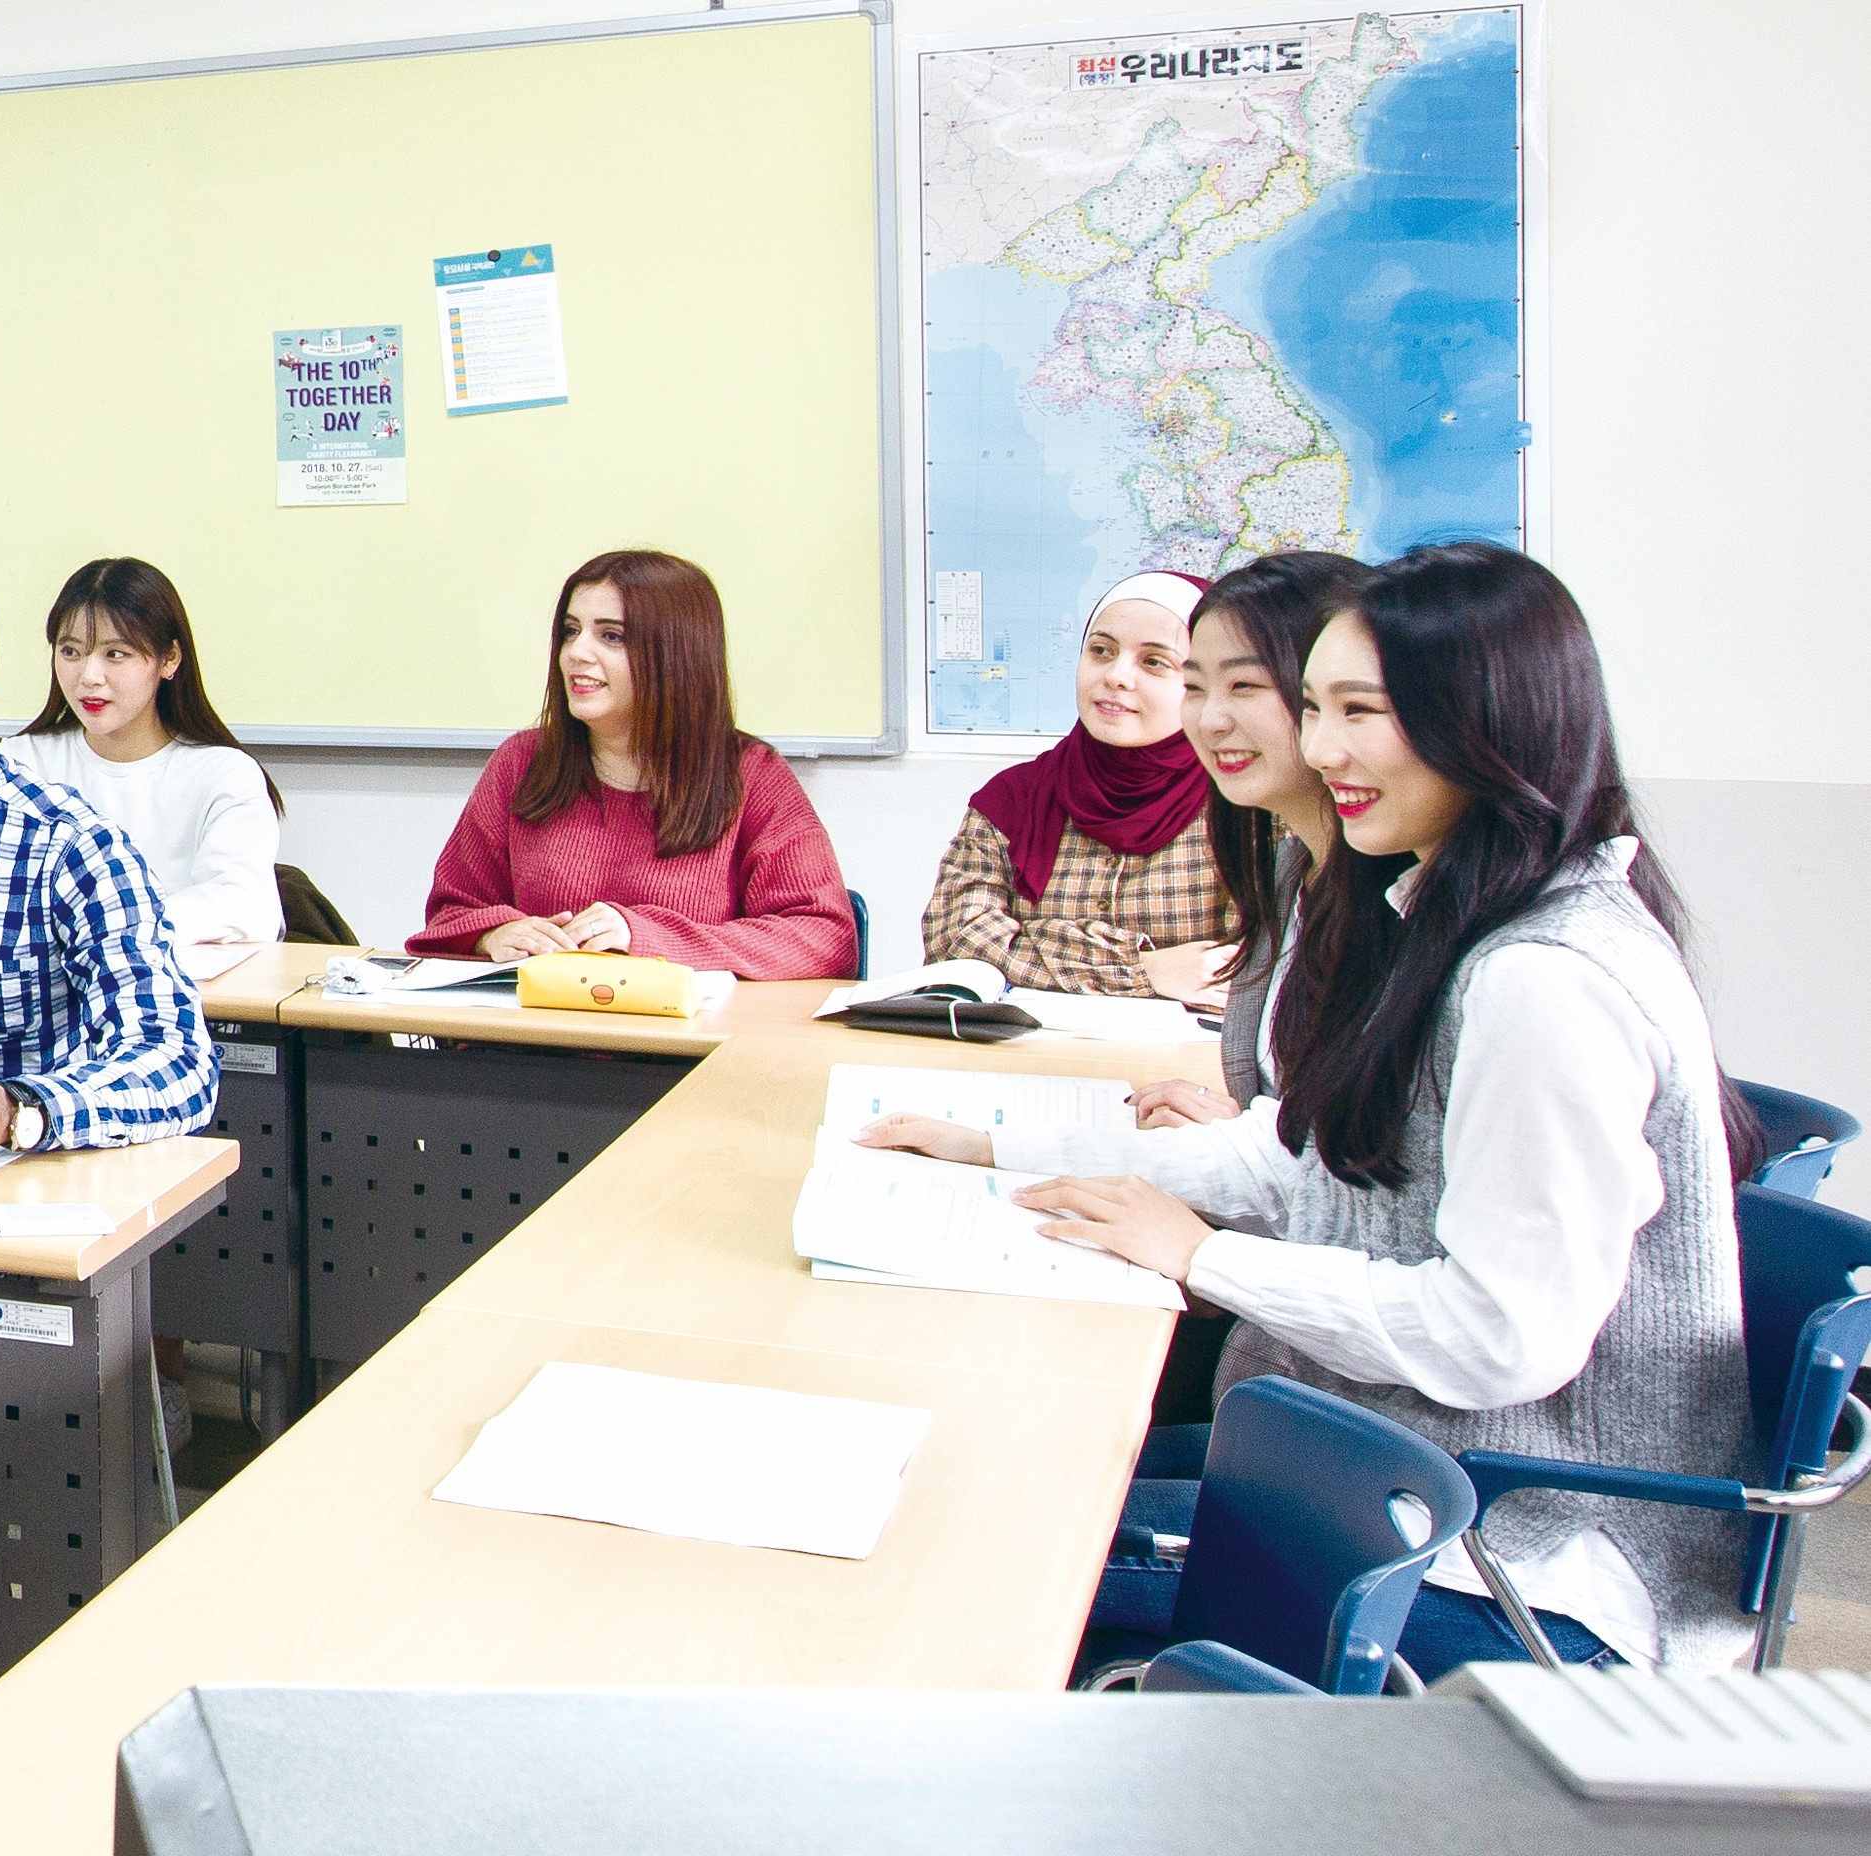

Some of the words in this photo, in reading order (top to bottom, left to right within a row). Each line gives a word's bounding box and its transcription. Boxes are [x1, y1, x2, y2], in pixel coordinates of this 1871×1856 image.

[1077, 57, 1116, 73] 최신
[1120, 41, 1303, 83] 우리나라지도
[293, 361, 333, 382] THE
[339, 359, 377, 380] 10TH
[286, 385, 392, 407] TOGETHER
[323, 411, 360, 431] DAY
